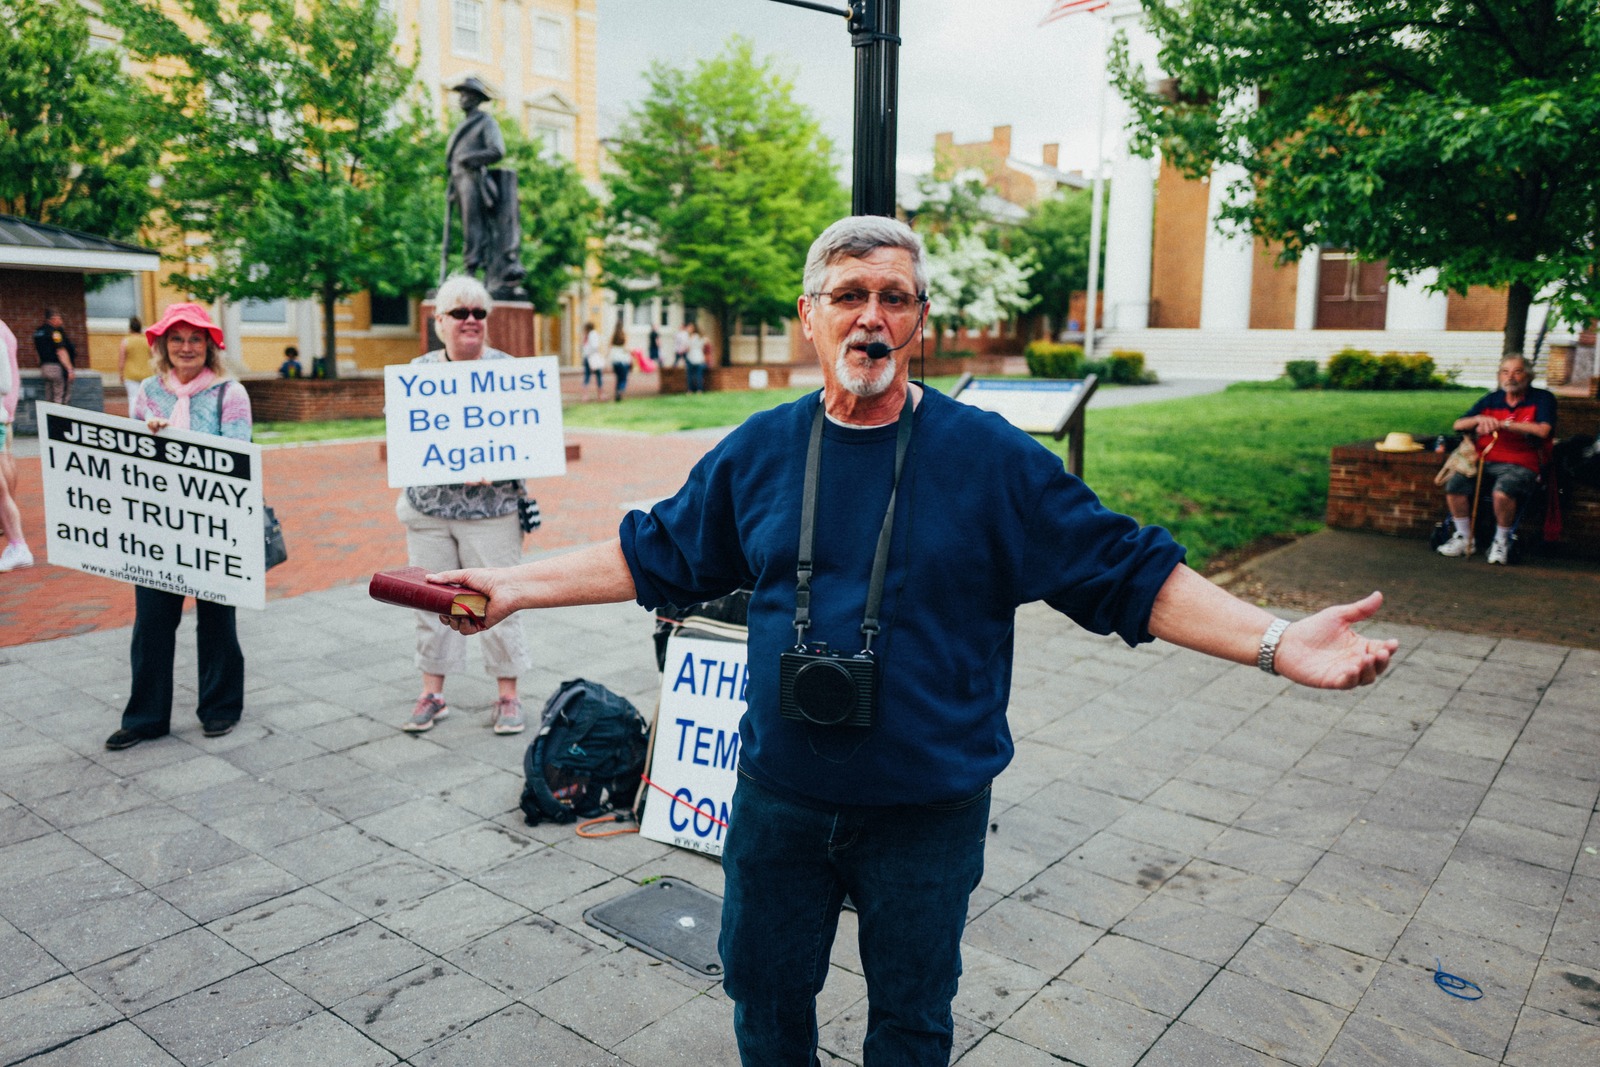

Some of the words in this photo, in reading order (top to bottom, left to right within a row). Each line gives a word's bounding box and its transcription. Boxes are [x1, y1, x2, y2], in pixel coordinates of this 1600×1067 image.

[398, 374, 457, 397] You
[470, 369, 548, 393] Must
[409, 409, 450, 432] Be
[463, 405, 540, 429] Born
[63, 422, 157, 458] JESUS
[164, 441, 235, 473] SAID
[422, 439, 530, 472] Again.
[48, 446, 56, 469] I
[65, 451, 111, 481] AM
[121, 463, 168, 492] the
[178, 473, 253, 516] WAY,
[66, 486, 112, 515] the
[122, 497, 238, 547] TRUTH,
[56, 522, 108, 549] and
[119, 532, 164, 561] the
[176, 543, 252, 581] LIFE.
[81, 561, 227, 602] www.sinawarenessday.com
[121, 562, 153, 577] John
[158, 570, 185, 584] 14:6
